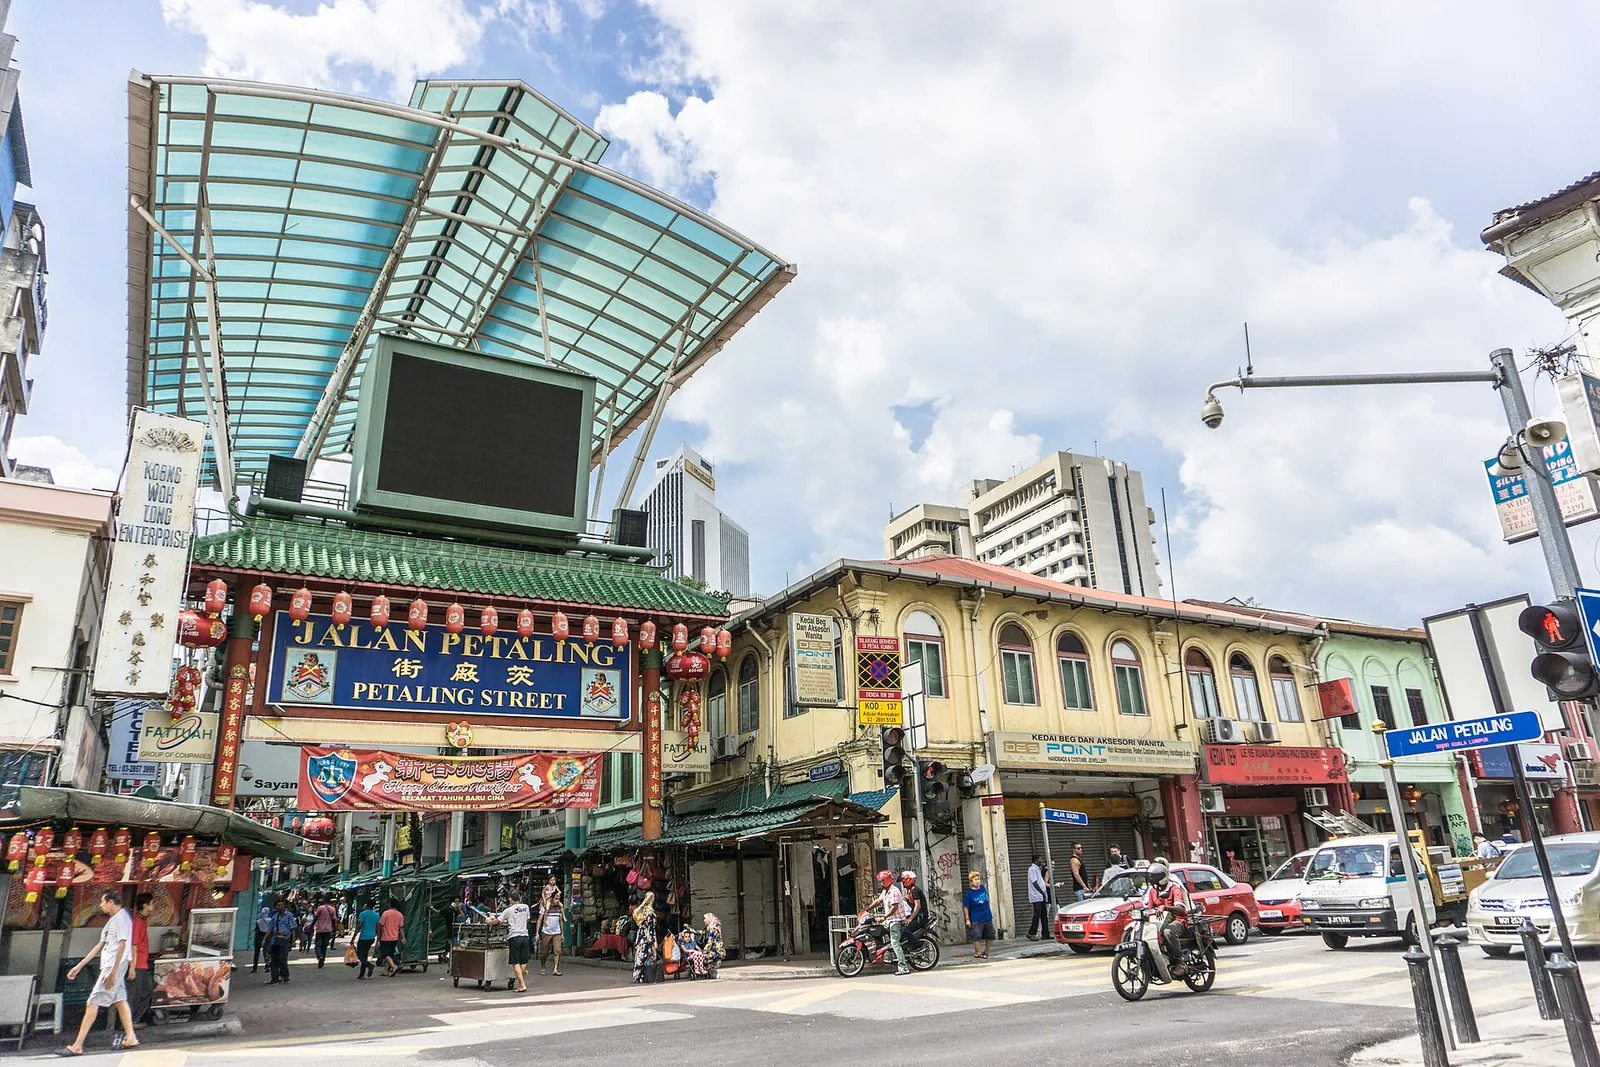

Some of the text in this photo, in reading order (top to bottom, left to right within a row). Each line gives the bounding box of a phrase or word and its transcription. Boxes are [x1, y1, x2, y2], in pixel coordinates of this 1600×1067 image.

[147, 483, 175, 504] WOH
[118, 523, 190, 549] ENTERPRISE
[800, 616, 827, 627] Kedai Beg
[805, 631, 823, 640] Wanita
[294, 620, 615, 666] JALAN PETALING
[352, 682, 567, 710] PETALING STREET
[864, 702, 879, 710] KOD
[145, 726, 213, 740] FATTUAH
[1408, 718, 1514, 744] JALAN PETALING
[1032, 734, 1166, 748] KEDAI BEG DAN AKSESORI WANITA
[140, 750, 163, 758] GROUP
[174, 752, 211, 760] COMPANIES
[664, 743, 707, 754] FATTAH
[382, 779, 426, 796] Happy
[468, 780, 496, 793] New
[490, 780, 524, 796] Year
